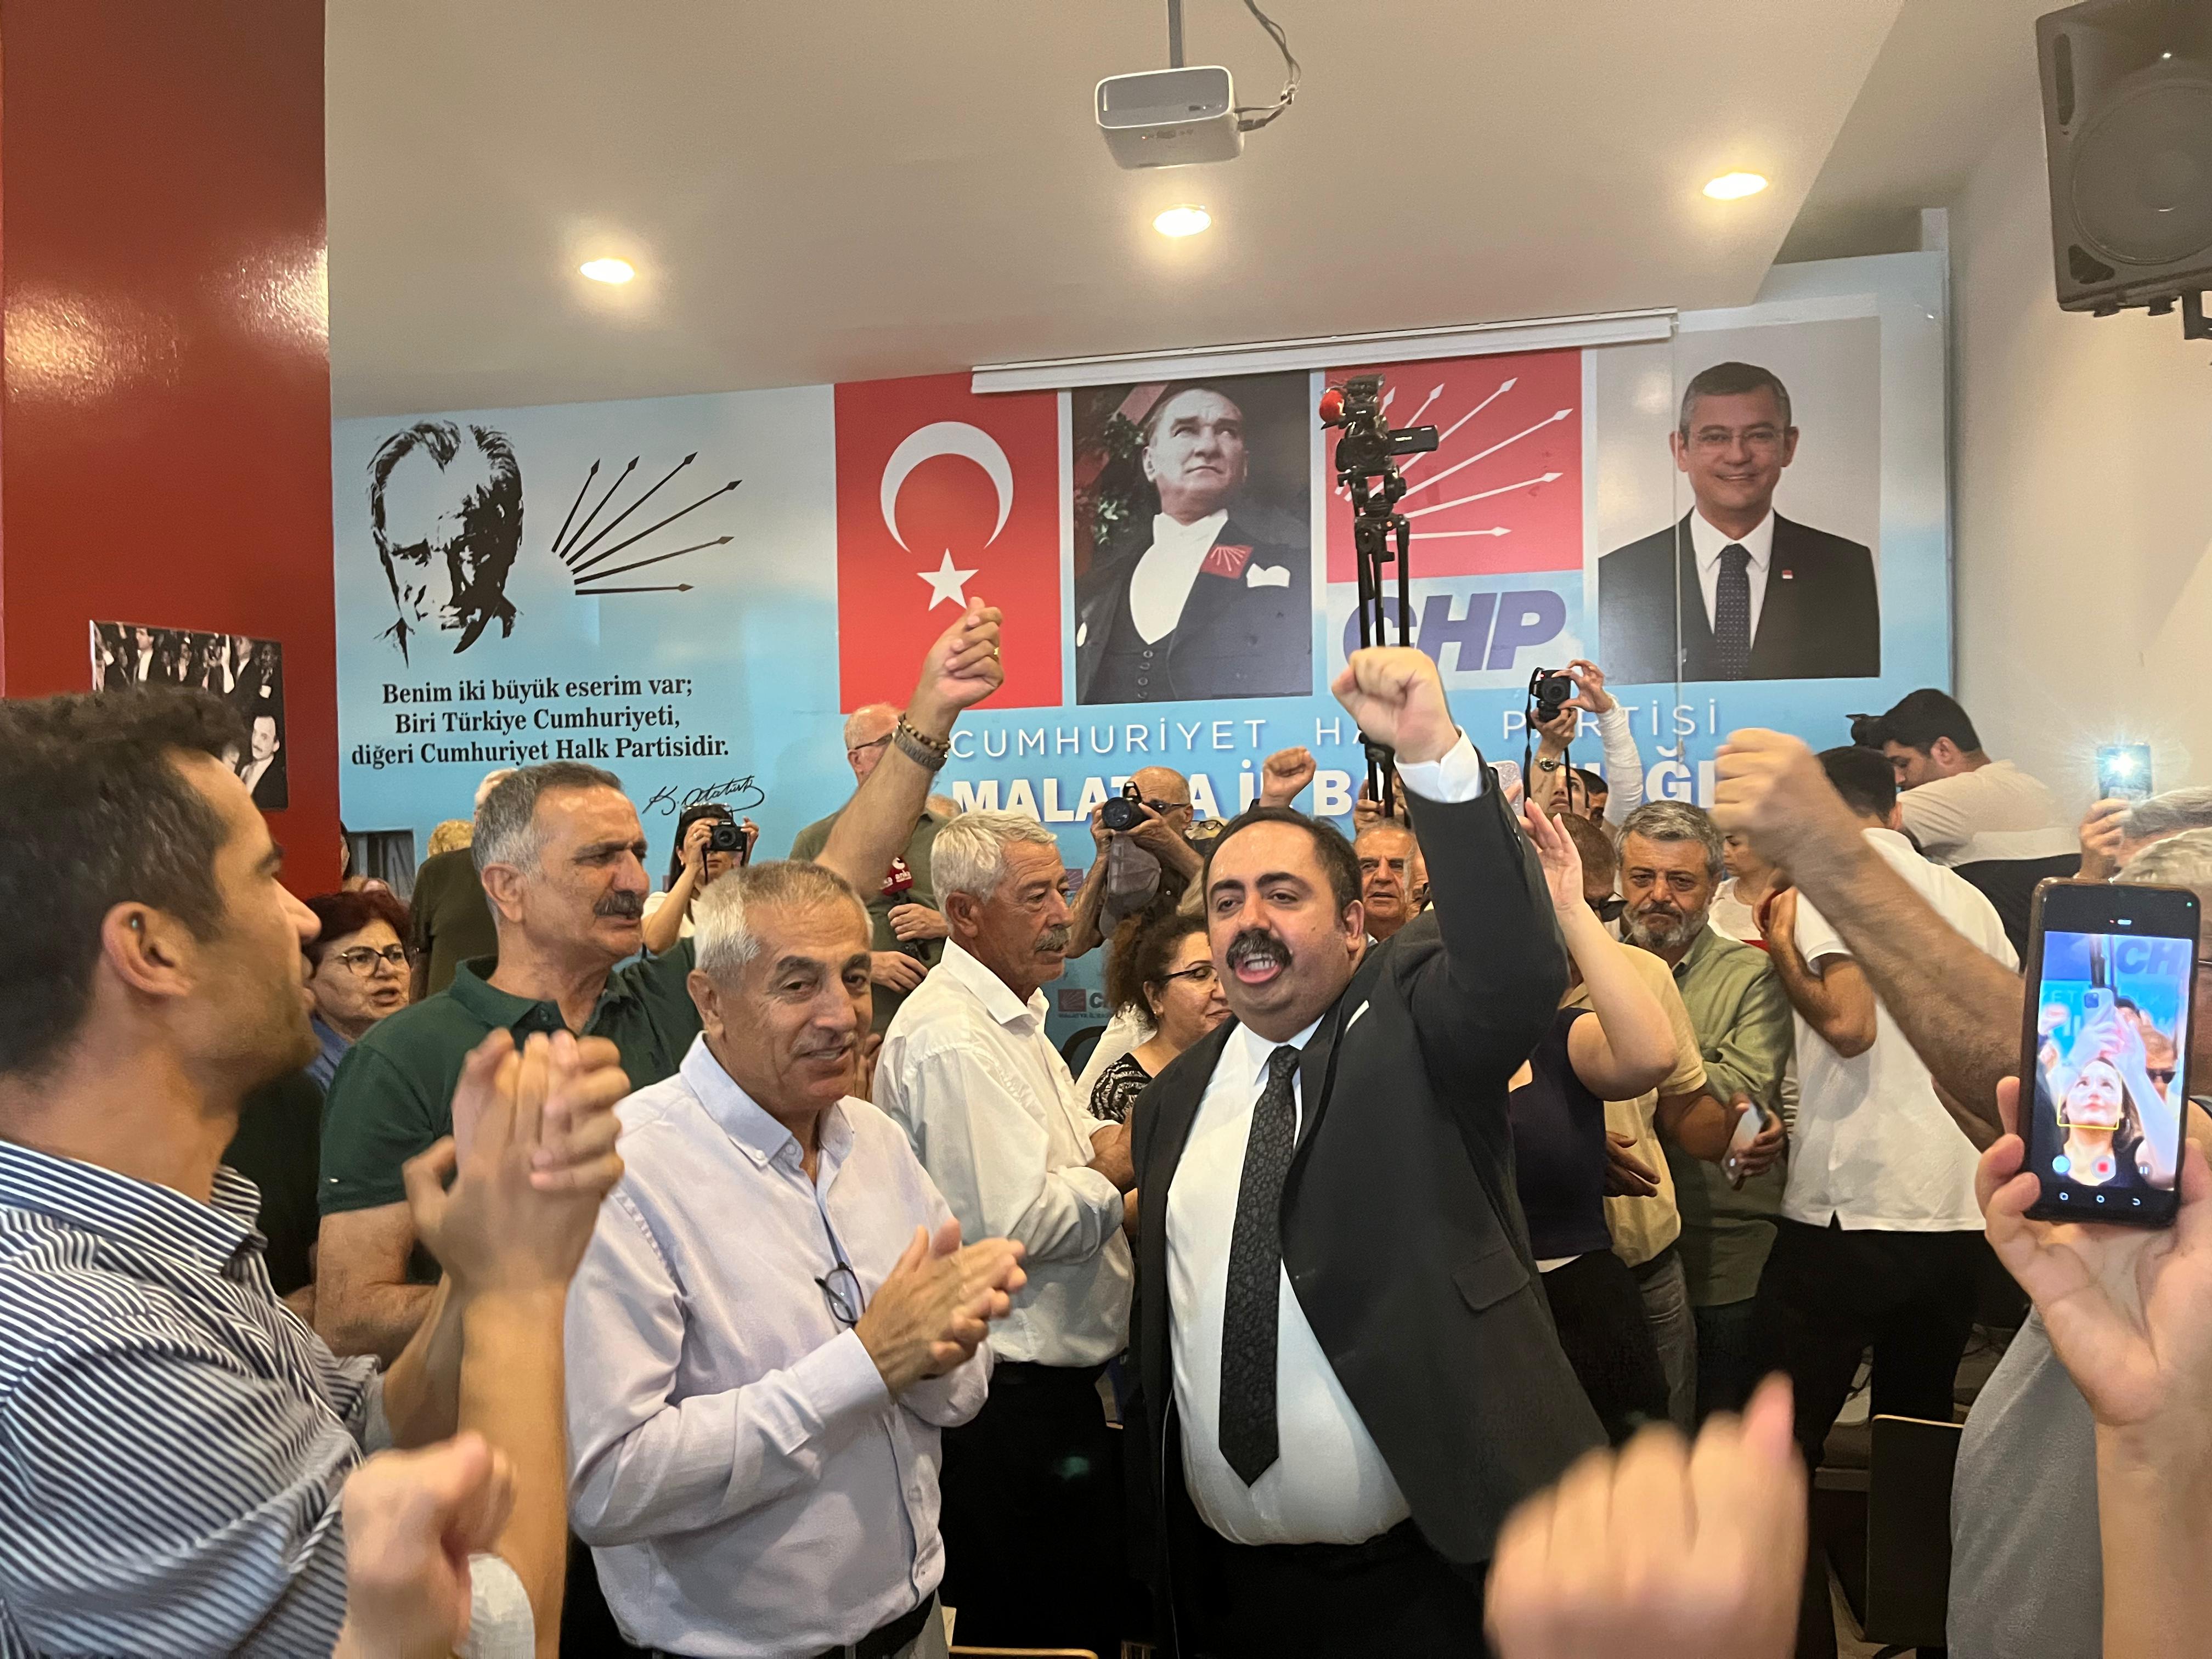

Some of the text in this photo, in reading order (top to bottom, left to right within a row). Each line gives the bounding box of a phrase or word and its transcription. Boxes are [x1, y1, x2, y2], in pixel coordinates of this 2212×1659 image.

[382, 675, 692, 704] Benim iki büyük eserim var;
[396, 704, 680, 736] Biri Türkiye Cumhuriyeti,
[352, 735, 729, 770] diğeri Cumhuriyet Halk Partisidir.
[950, 718, 1266, 758] CUMHURİYET
